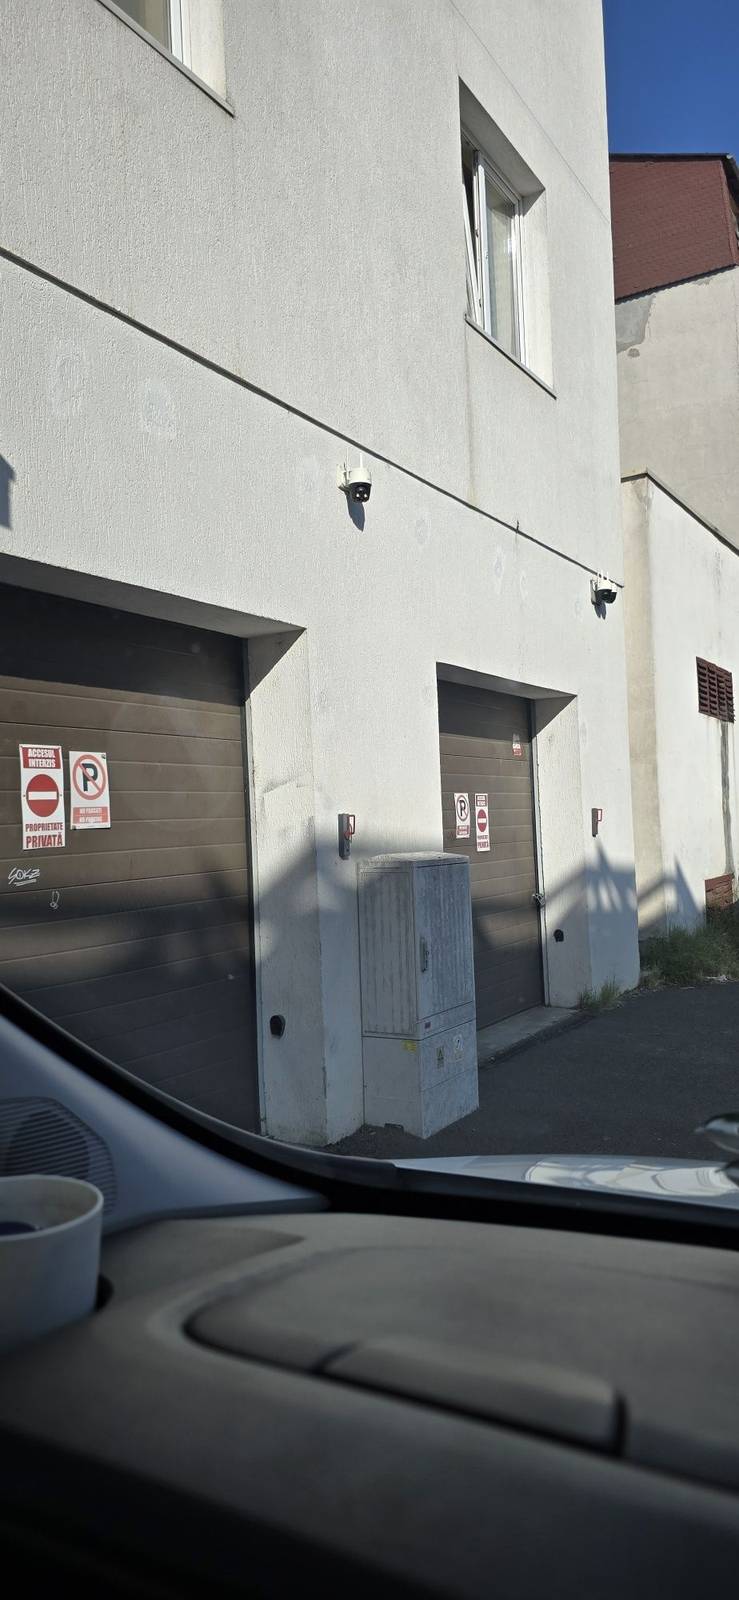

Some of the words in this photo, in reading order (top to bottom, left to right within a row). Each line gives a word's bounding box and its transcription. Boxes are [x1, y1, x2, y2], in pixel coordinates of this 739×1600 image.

[28, 748, 56, 758] ACCESUL
[28, 758, 56, 768] INTERZIS
[25, 822, 63, 832] PROPRIETATE
[26, 832, 63, 848] PRIVATĂ
